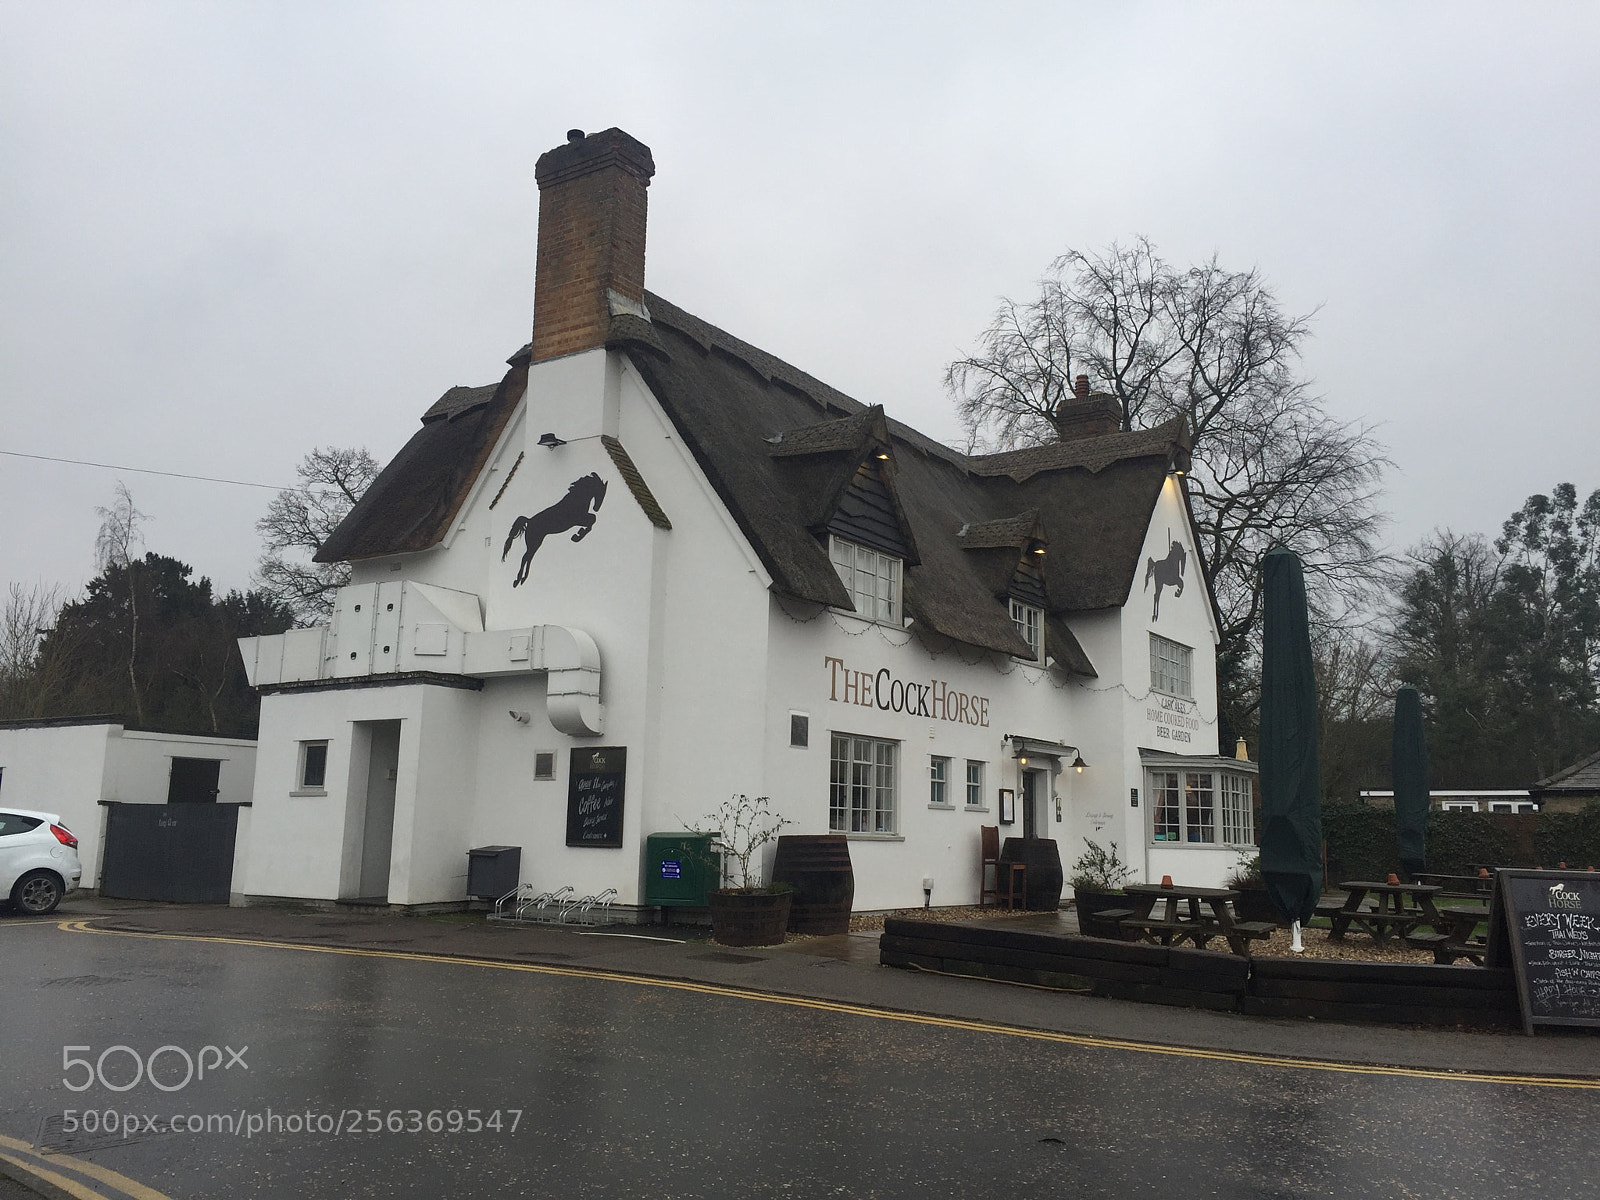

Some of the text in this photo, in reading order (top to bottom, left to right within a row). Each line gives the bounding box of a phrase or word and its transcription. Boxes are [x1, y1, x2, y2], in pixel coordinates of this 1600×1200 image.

[824, 655, 990, 728] THE COCK HORSE
[1146, 708, 1199, 731] HOME COOKED FOOD
[1156, 726, 1191, 743] BEER GARDEN
[578, 794, 602, 815] Coffee
[1548, 898, 1582, 909] HORSE
[1555, 890, 1581, 901] COCK
[1524, 912, 1561, 929] EVERY
[1548, 948, 1579, 960] BURGER
